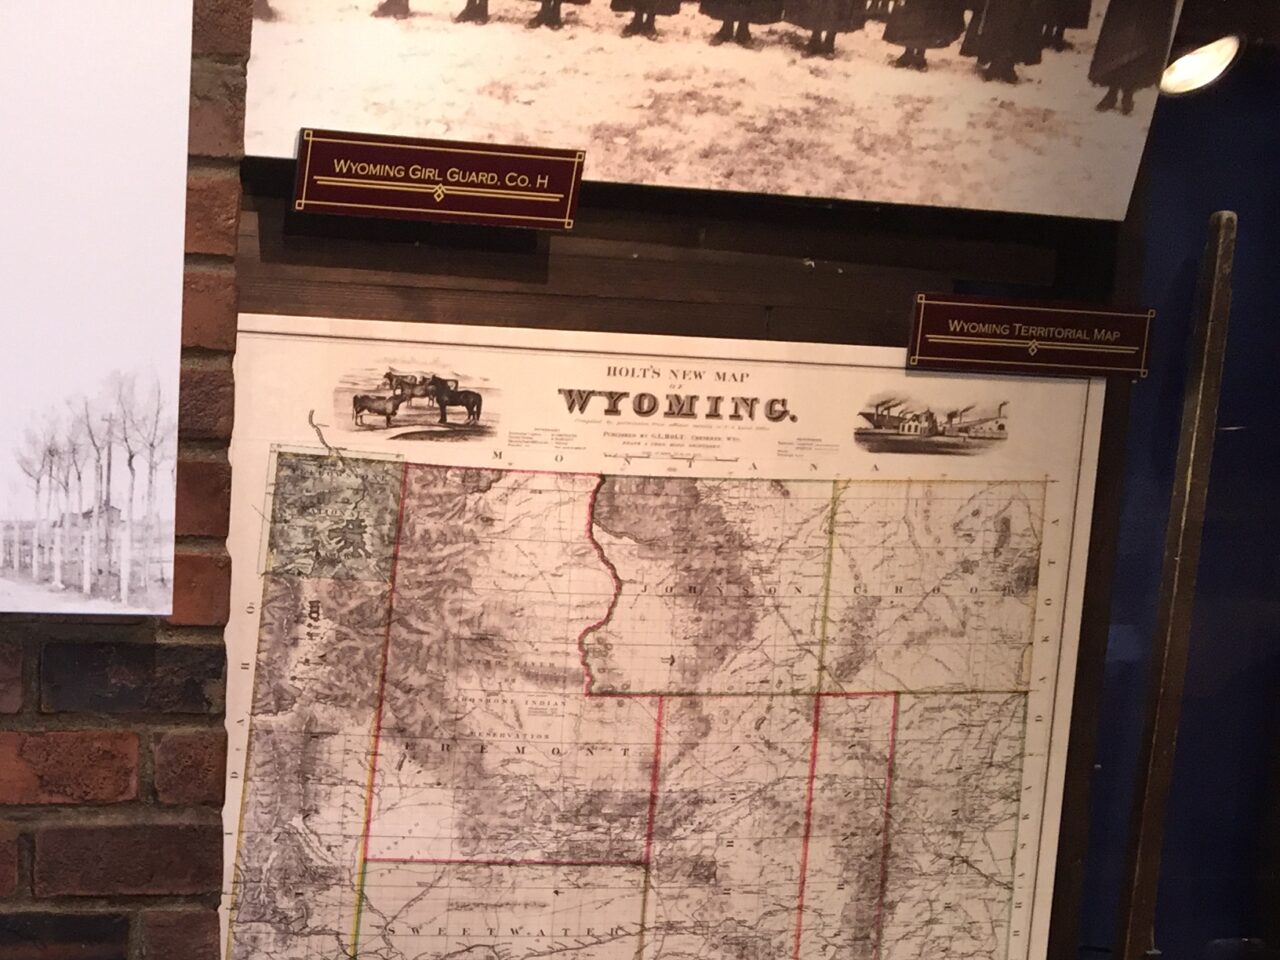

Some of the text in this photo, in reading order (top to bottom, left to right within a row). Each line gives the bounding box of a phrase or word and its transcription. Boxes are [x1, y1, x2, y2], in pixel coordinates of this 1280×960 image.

[334, 158, 405, 178] WYOMING
[409, 164, 442, 181] GIRL
[536, 174, 549, 189] H
[948, 319, 1121, 342] WYOMING TERRITORIAL MAP
[606, 364, 751, 384] HOLT'S NEW MAP
[557, 387, 799, 424] WYOMING.
